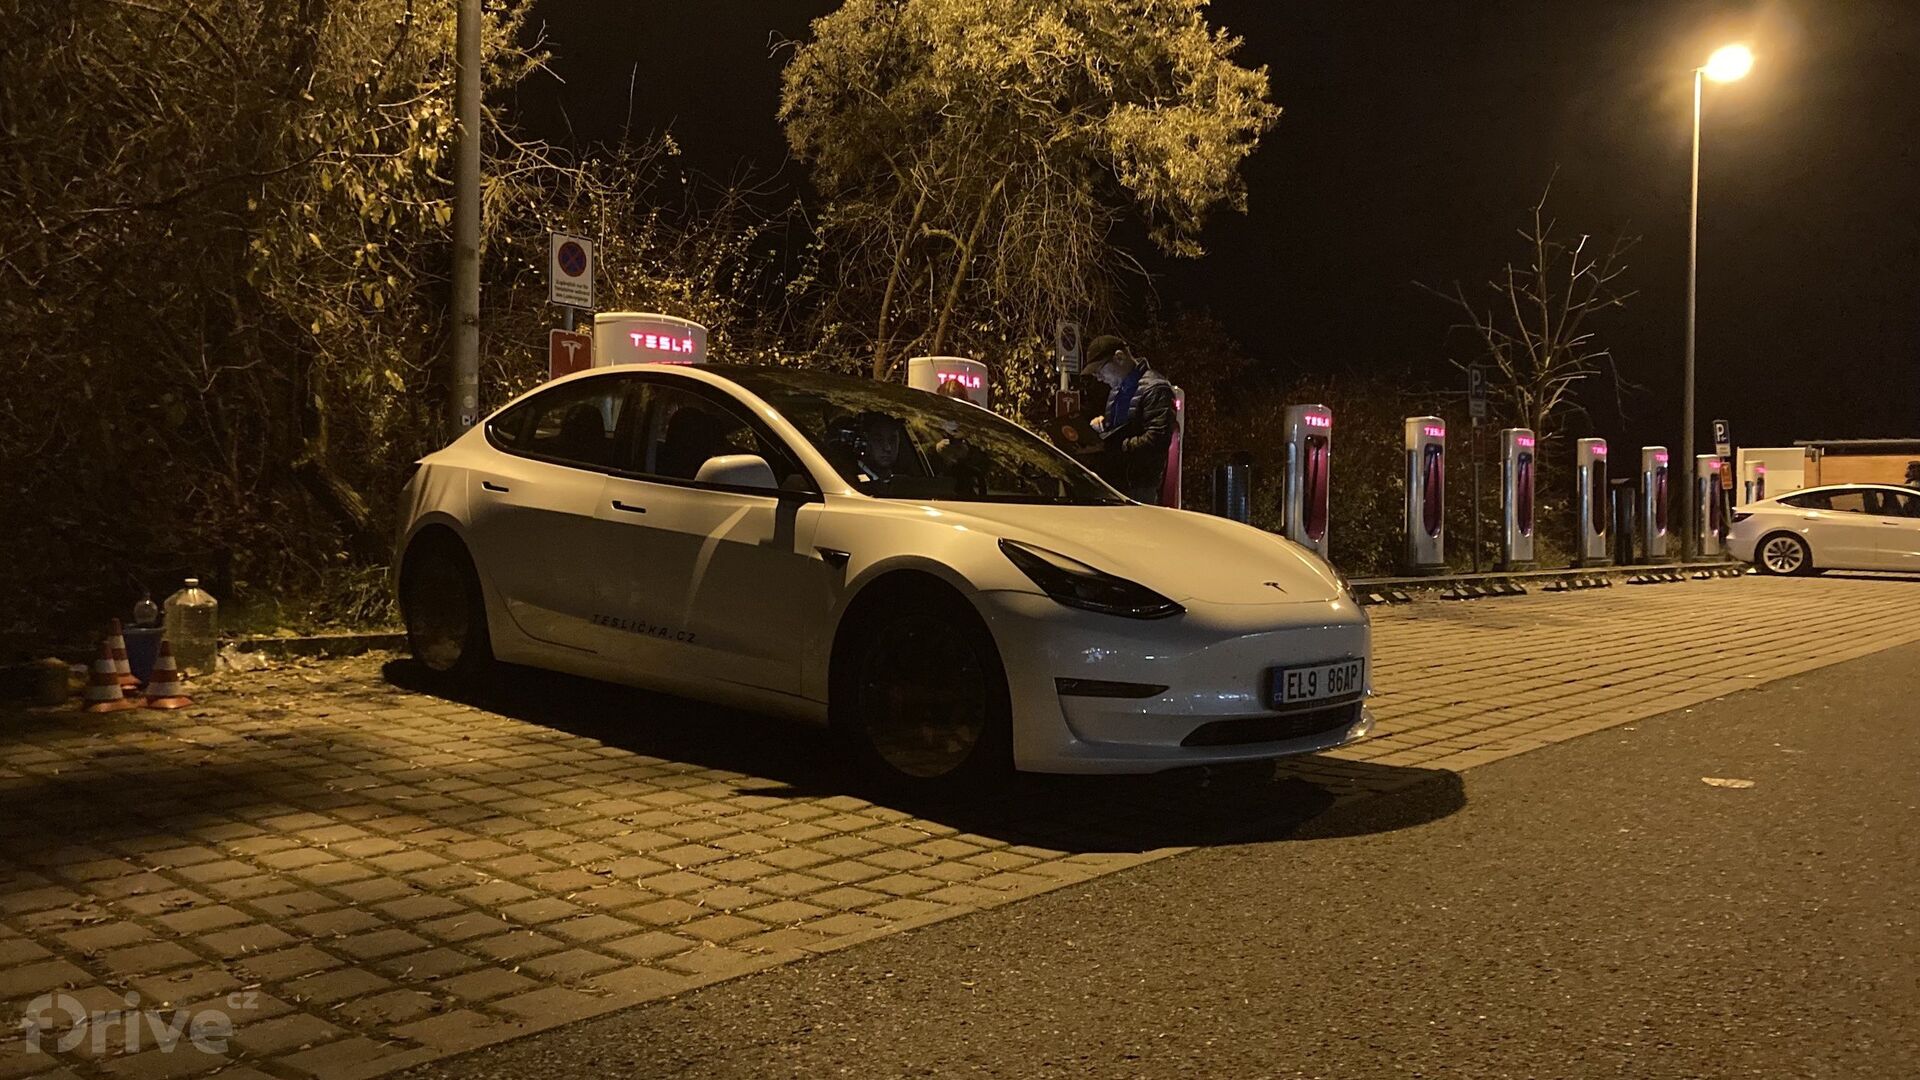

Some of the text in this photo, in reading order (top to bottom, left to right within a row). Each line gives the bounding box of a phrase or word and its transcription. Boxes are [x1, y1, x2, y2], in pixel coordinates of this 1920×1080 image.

[630, 333, 692, 353] TESLA
[1715, 423, 1725, 442] P
[1287, 665, 1358, 700] EL9 86AP
